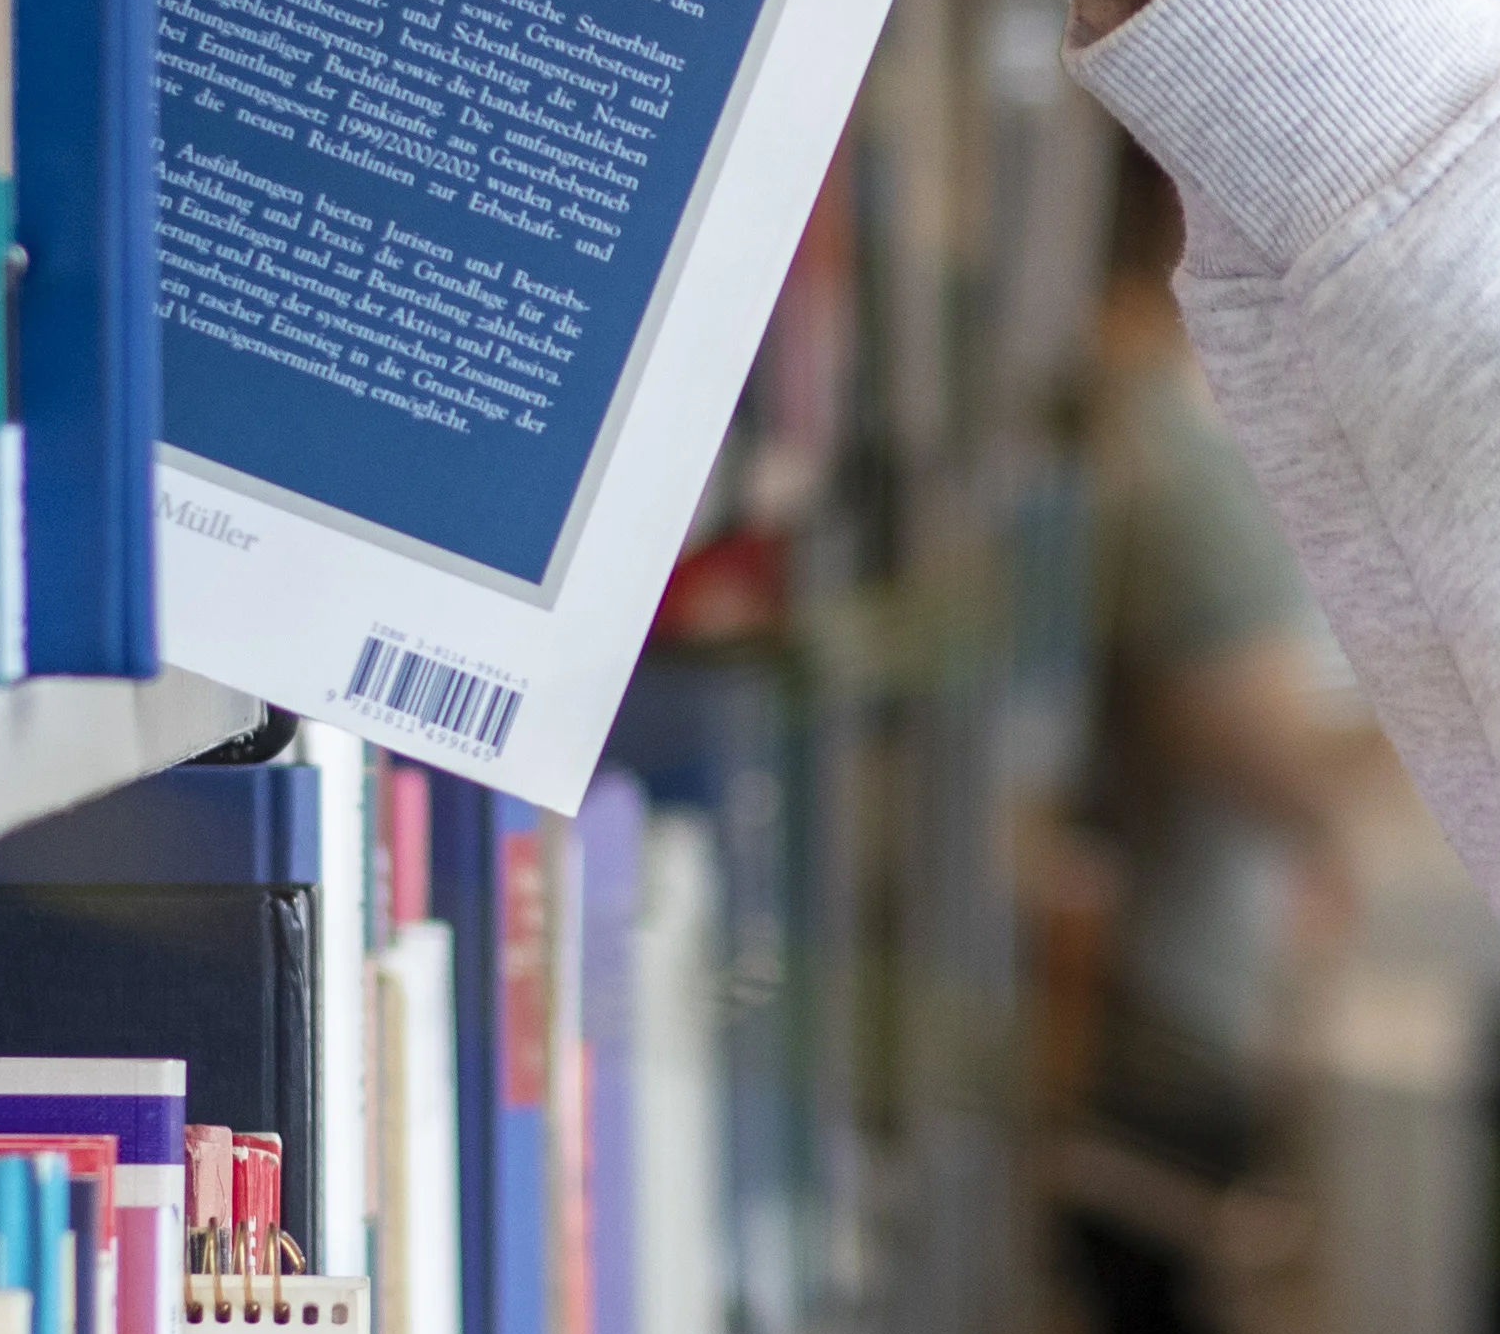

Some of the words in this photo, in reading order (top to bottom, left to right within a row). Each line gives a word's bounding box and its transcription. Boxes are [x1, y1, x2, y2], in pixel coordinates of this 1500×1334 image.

[398, 25, 532, 95] berücksichtigt
[544, 84, 578, 112] die
[590, 100, 657, 140] Neuer-
[400, 5, 443, 32] und
[449, 20, 619, 102] Schenkungsteuer)
[628, 94, 670, 120] und
[458, 1, 514, 33] sowie
[524, 21, 675, 98] Gewerbesteuer),
[574, 13, 686, 72] Steuerbilanz
[153, 14, 188, 44] bei
[195, 30, 298, 89] Ermittlung
[304, 74, 339, 101] der
[346, 88, 438, 140] Einkünfte
[445, 133, 479, 156] aus
[487, 144, 631, 214] Gewerbebetrieb
[192, 86, 226, 113] die
[234, 106, 296, 141] neuen
[305, 127, 416, 187] Richtlinien
[424, 180, 459, 203] zur
[466, 189, 563, 241] Erbschaft-
[573, 237, 616, 263] und
[322, 51, 447, 118] Buchführung.
[457, 104, 495, 135] Die
[503, 127, 640, 192] umfangreichen
[335, 112, 481, 184] 1999/2000/2002
[485, 175, 553, 213] wurden
[556, 200, 622, 238] ebenso
[390, 57, 444, 87] sowie
[444, 73, 476, 100] die
[477, 83, 649, 168] handelsrechtlichen
[151, 158, 255, 217] Ausbildung
[261, 205, 303, 232] und
[306, 217, 365, 256] Praxis
[372, 243, 405, 271] die
[411, 258, 509, 311] Grundlage
[515, 298, 546, 325] für
[551, 312, 584, 340] die
[174, 141, 305, 206] Ausführungen
[313, 191, 374, 232] bieten
[379, 218, 454, 263] Juristen
[463, 256, 505, 281] und
[510, 267, 591, 313] Betriebs-
[176, 194, 288, 254] Einzelfragen
[291, 244, 333, 271] und
[331, 260, 364, 282] zur
[365, 266, 473, 328] Beurteilung
[473, 314, 576, 364] zahlreicher
[151, 217, 214, 255] ierung
[213, 242, 255, 268] und
[253, 251, 353, 309] Bewertung
[352, 291, 387, 319] der
[386, 305, 452, 344] Aktiva
[453, 334, 495, 360] und
[492, 343, 562, 387] Passiva.
[151, 245, 281, 309] rausarbeitung
[279, 290, 315, 318] der
[313, 308, 449, 371] systematischen
[448, 354, 555, 409] Zusammen-
[157, 277, 191, 300] ein
[195, 290, 265, 326] rascher
[268, 311, 345, 361] Einstieg
[347, 347, 370, 368] in
[374, 354, 407, 381] die
[410, 368, 510, 421] Grundzüge
[513, 407, 547, 435] der
[178, 303, 370, 398] Vermögensermittlung
[368, 385, 471, 435] ermöglicht.
[154, 487, 260, 552] Müller
[323, 687, 338, 704] 9
